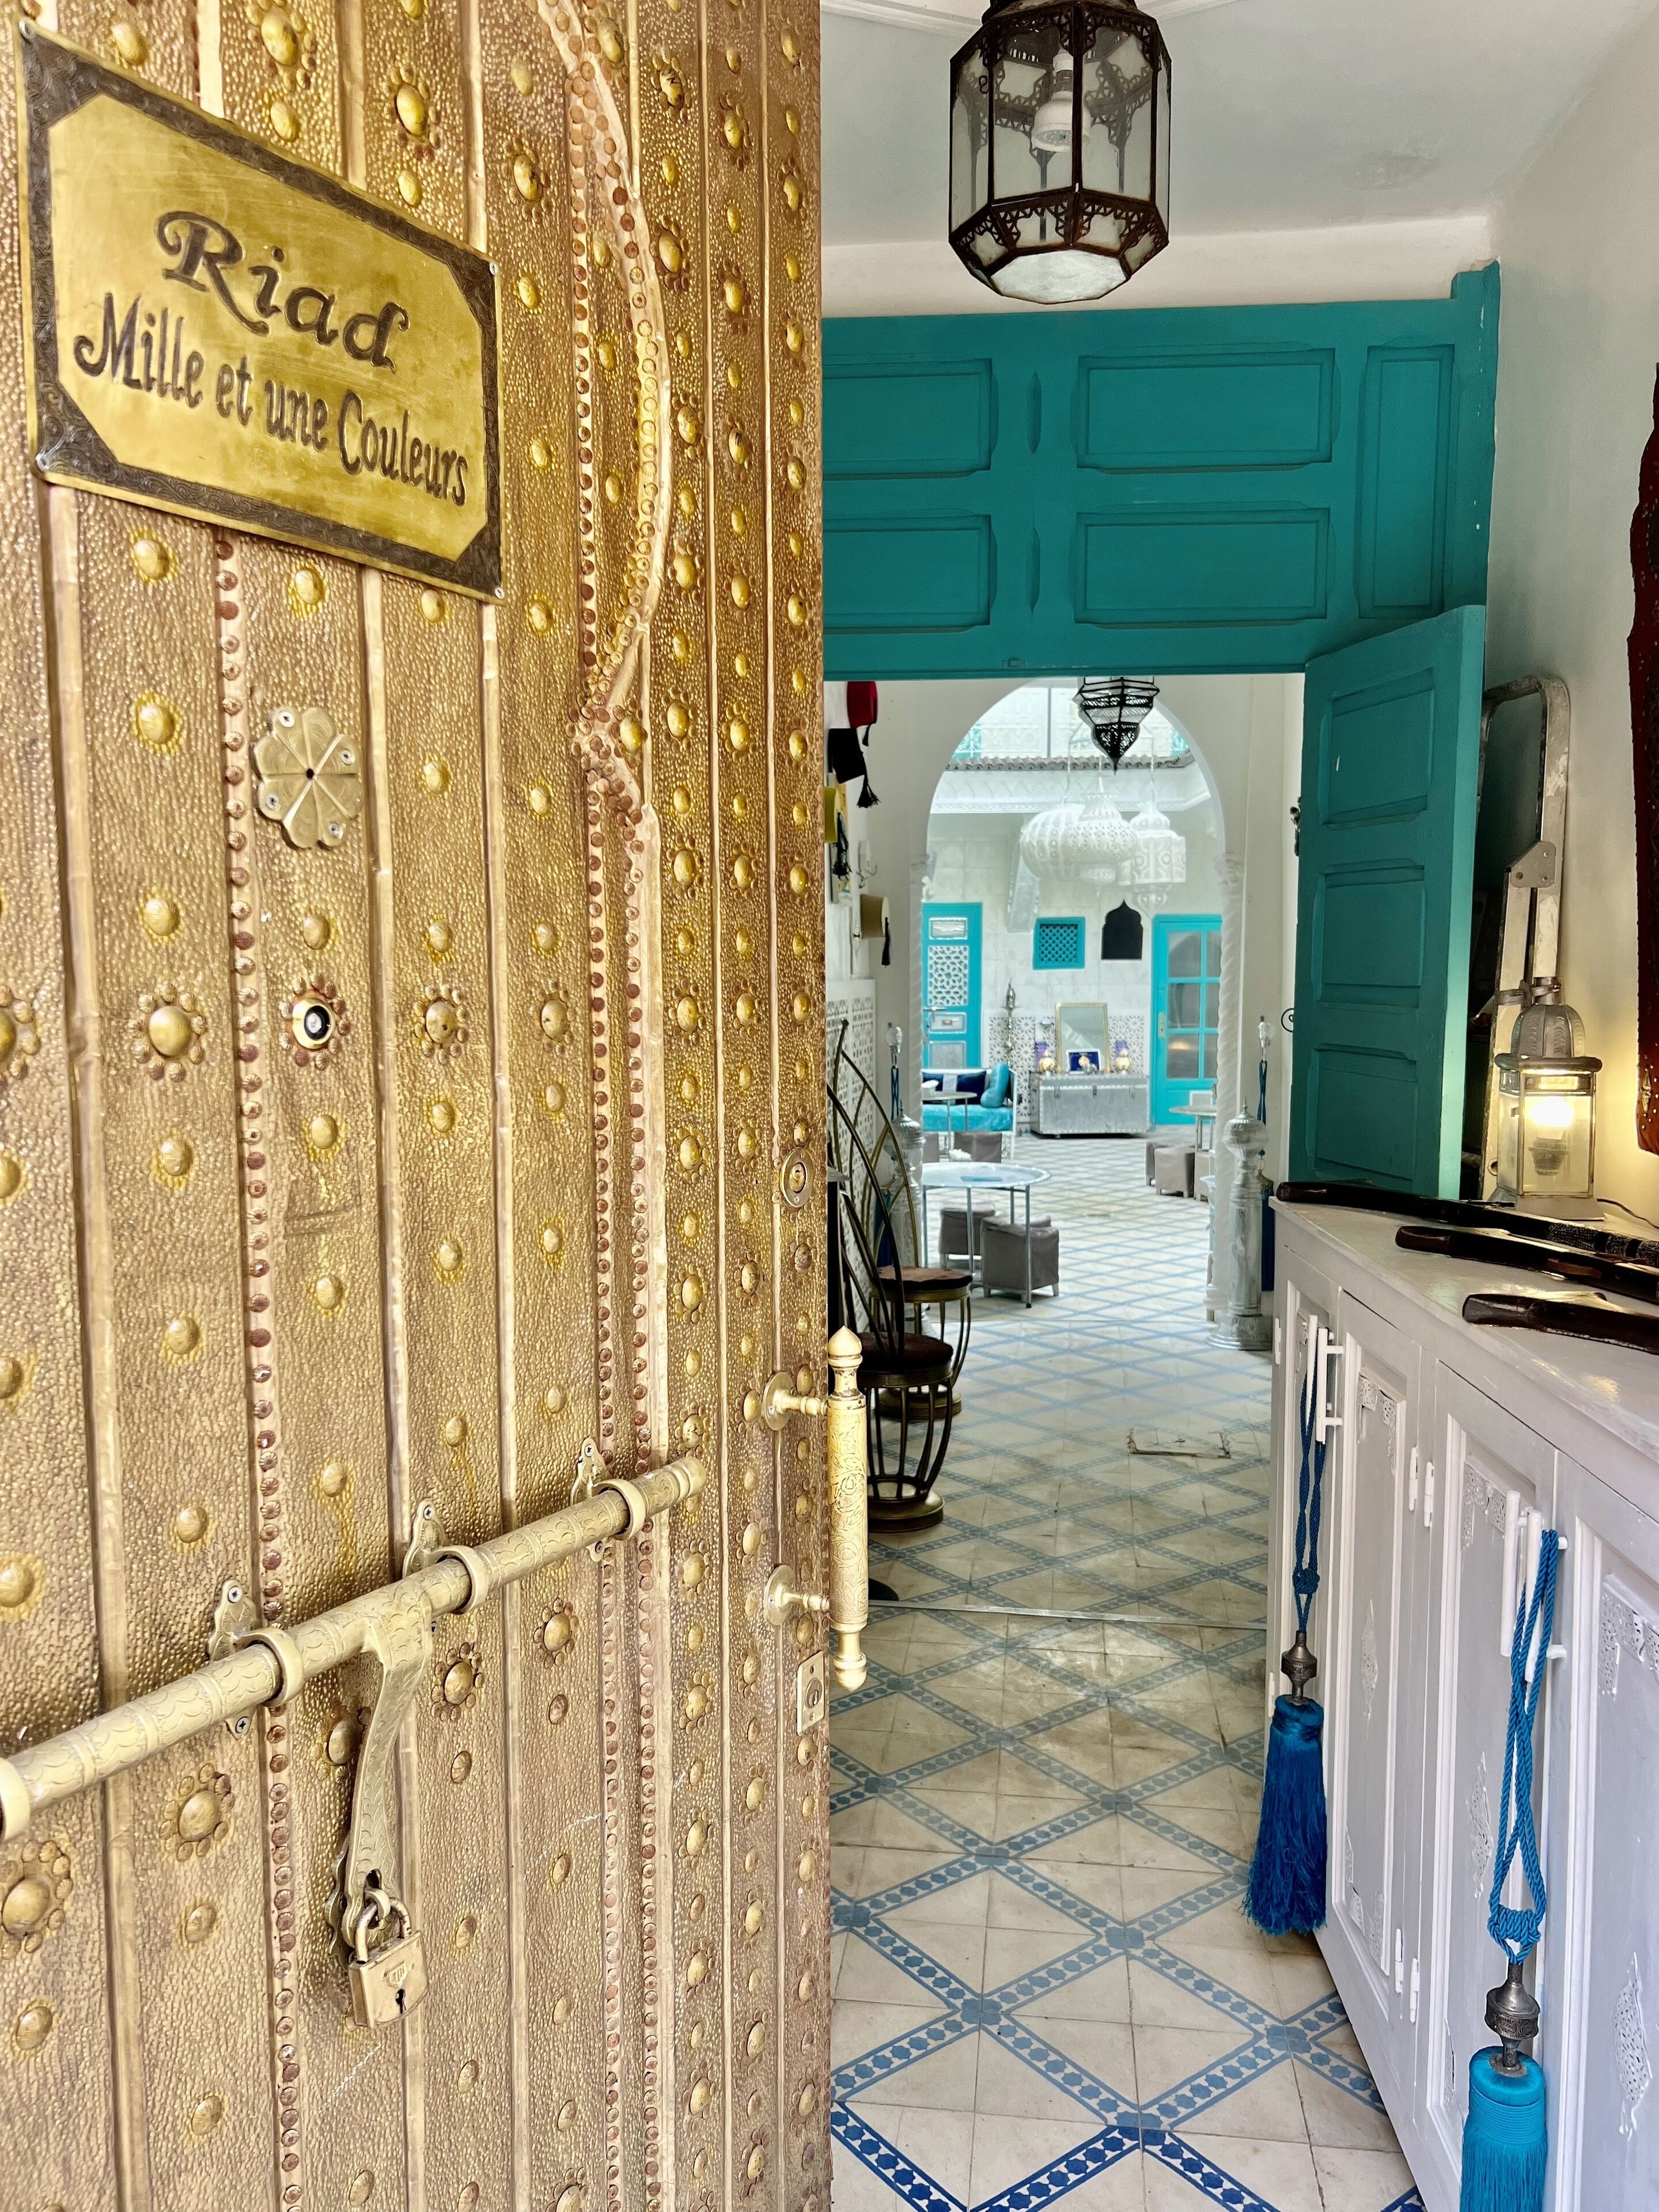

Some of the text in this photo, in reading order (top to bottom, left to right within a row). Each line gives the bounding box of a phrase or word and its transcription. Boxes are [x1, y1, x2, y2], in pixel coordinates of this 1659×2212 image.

[156, 211, 408, 372] Riad
[74, 293, 468, 506] Mille et une Couleurs
